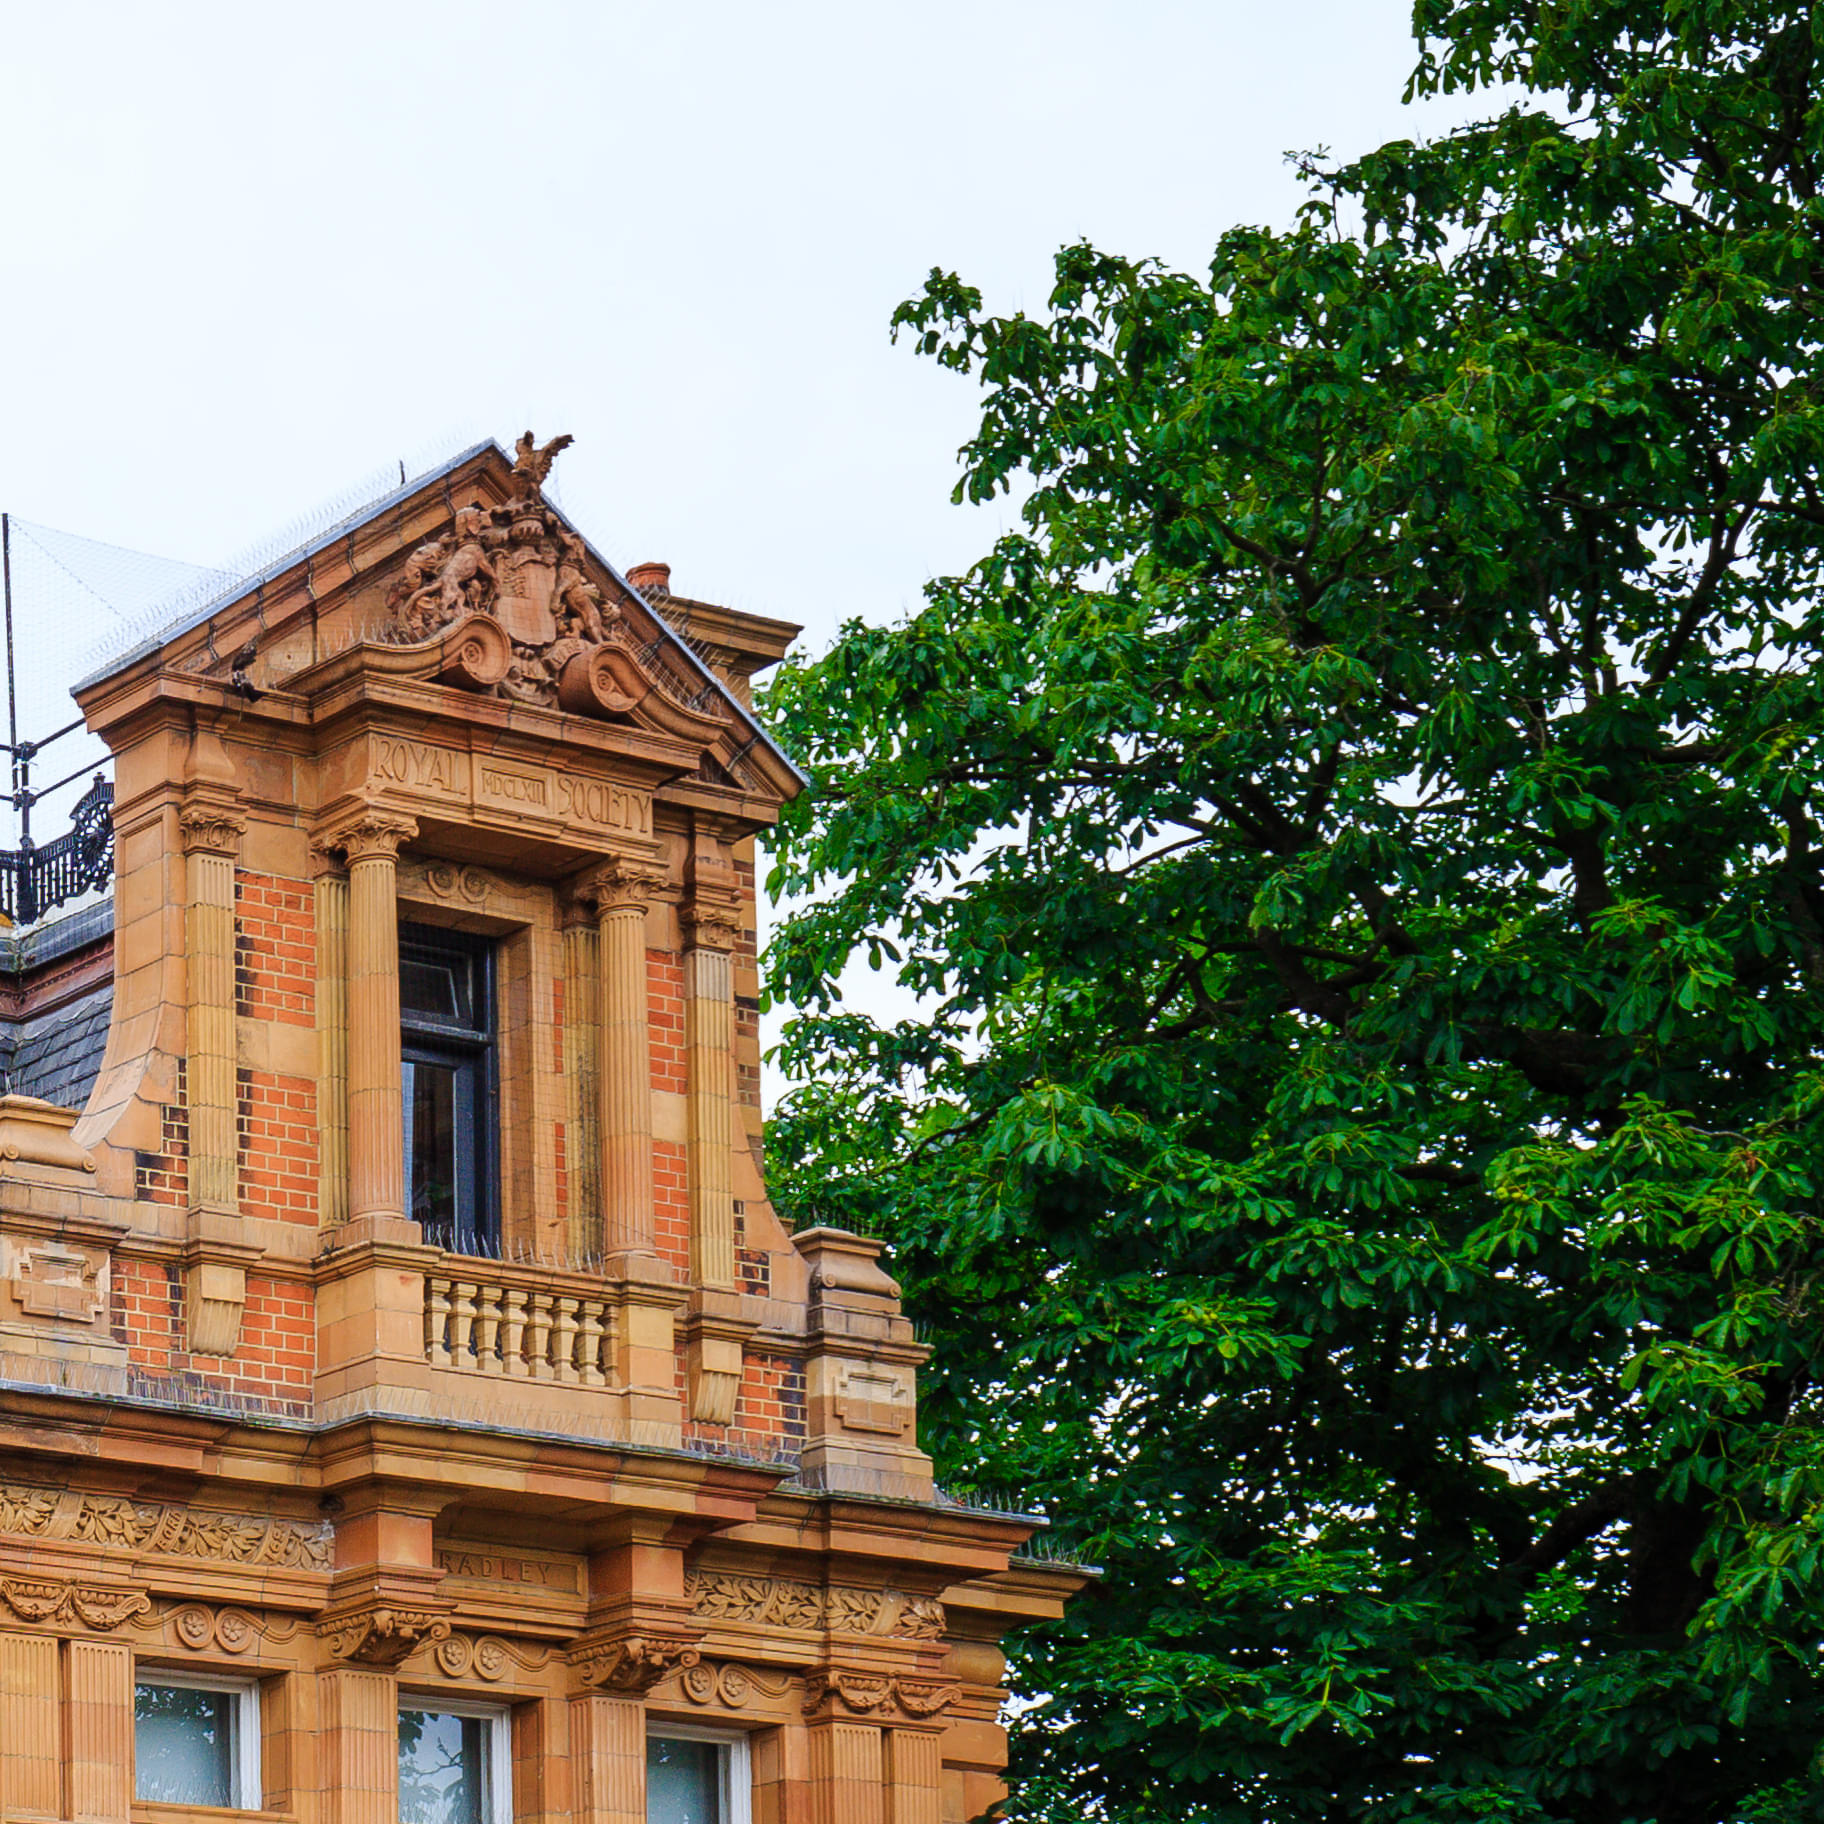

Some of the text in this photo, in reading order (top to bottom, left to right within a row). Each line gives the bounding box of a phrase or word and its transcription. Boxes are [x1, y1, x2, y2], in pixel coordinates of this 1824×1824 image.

[372, 733, 468, 796] ROYAL
[558, 775, 651, 833] SOCIETY
[439, 1550, 551, 1584] RADLEY
